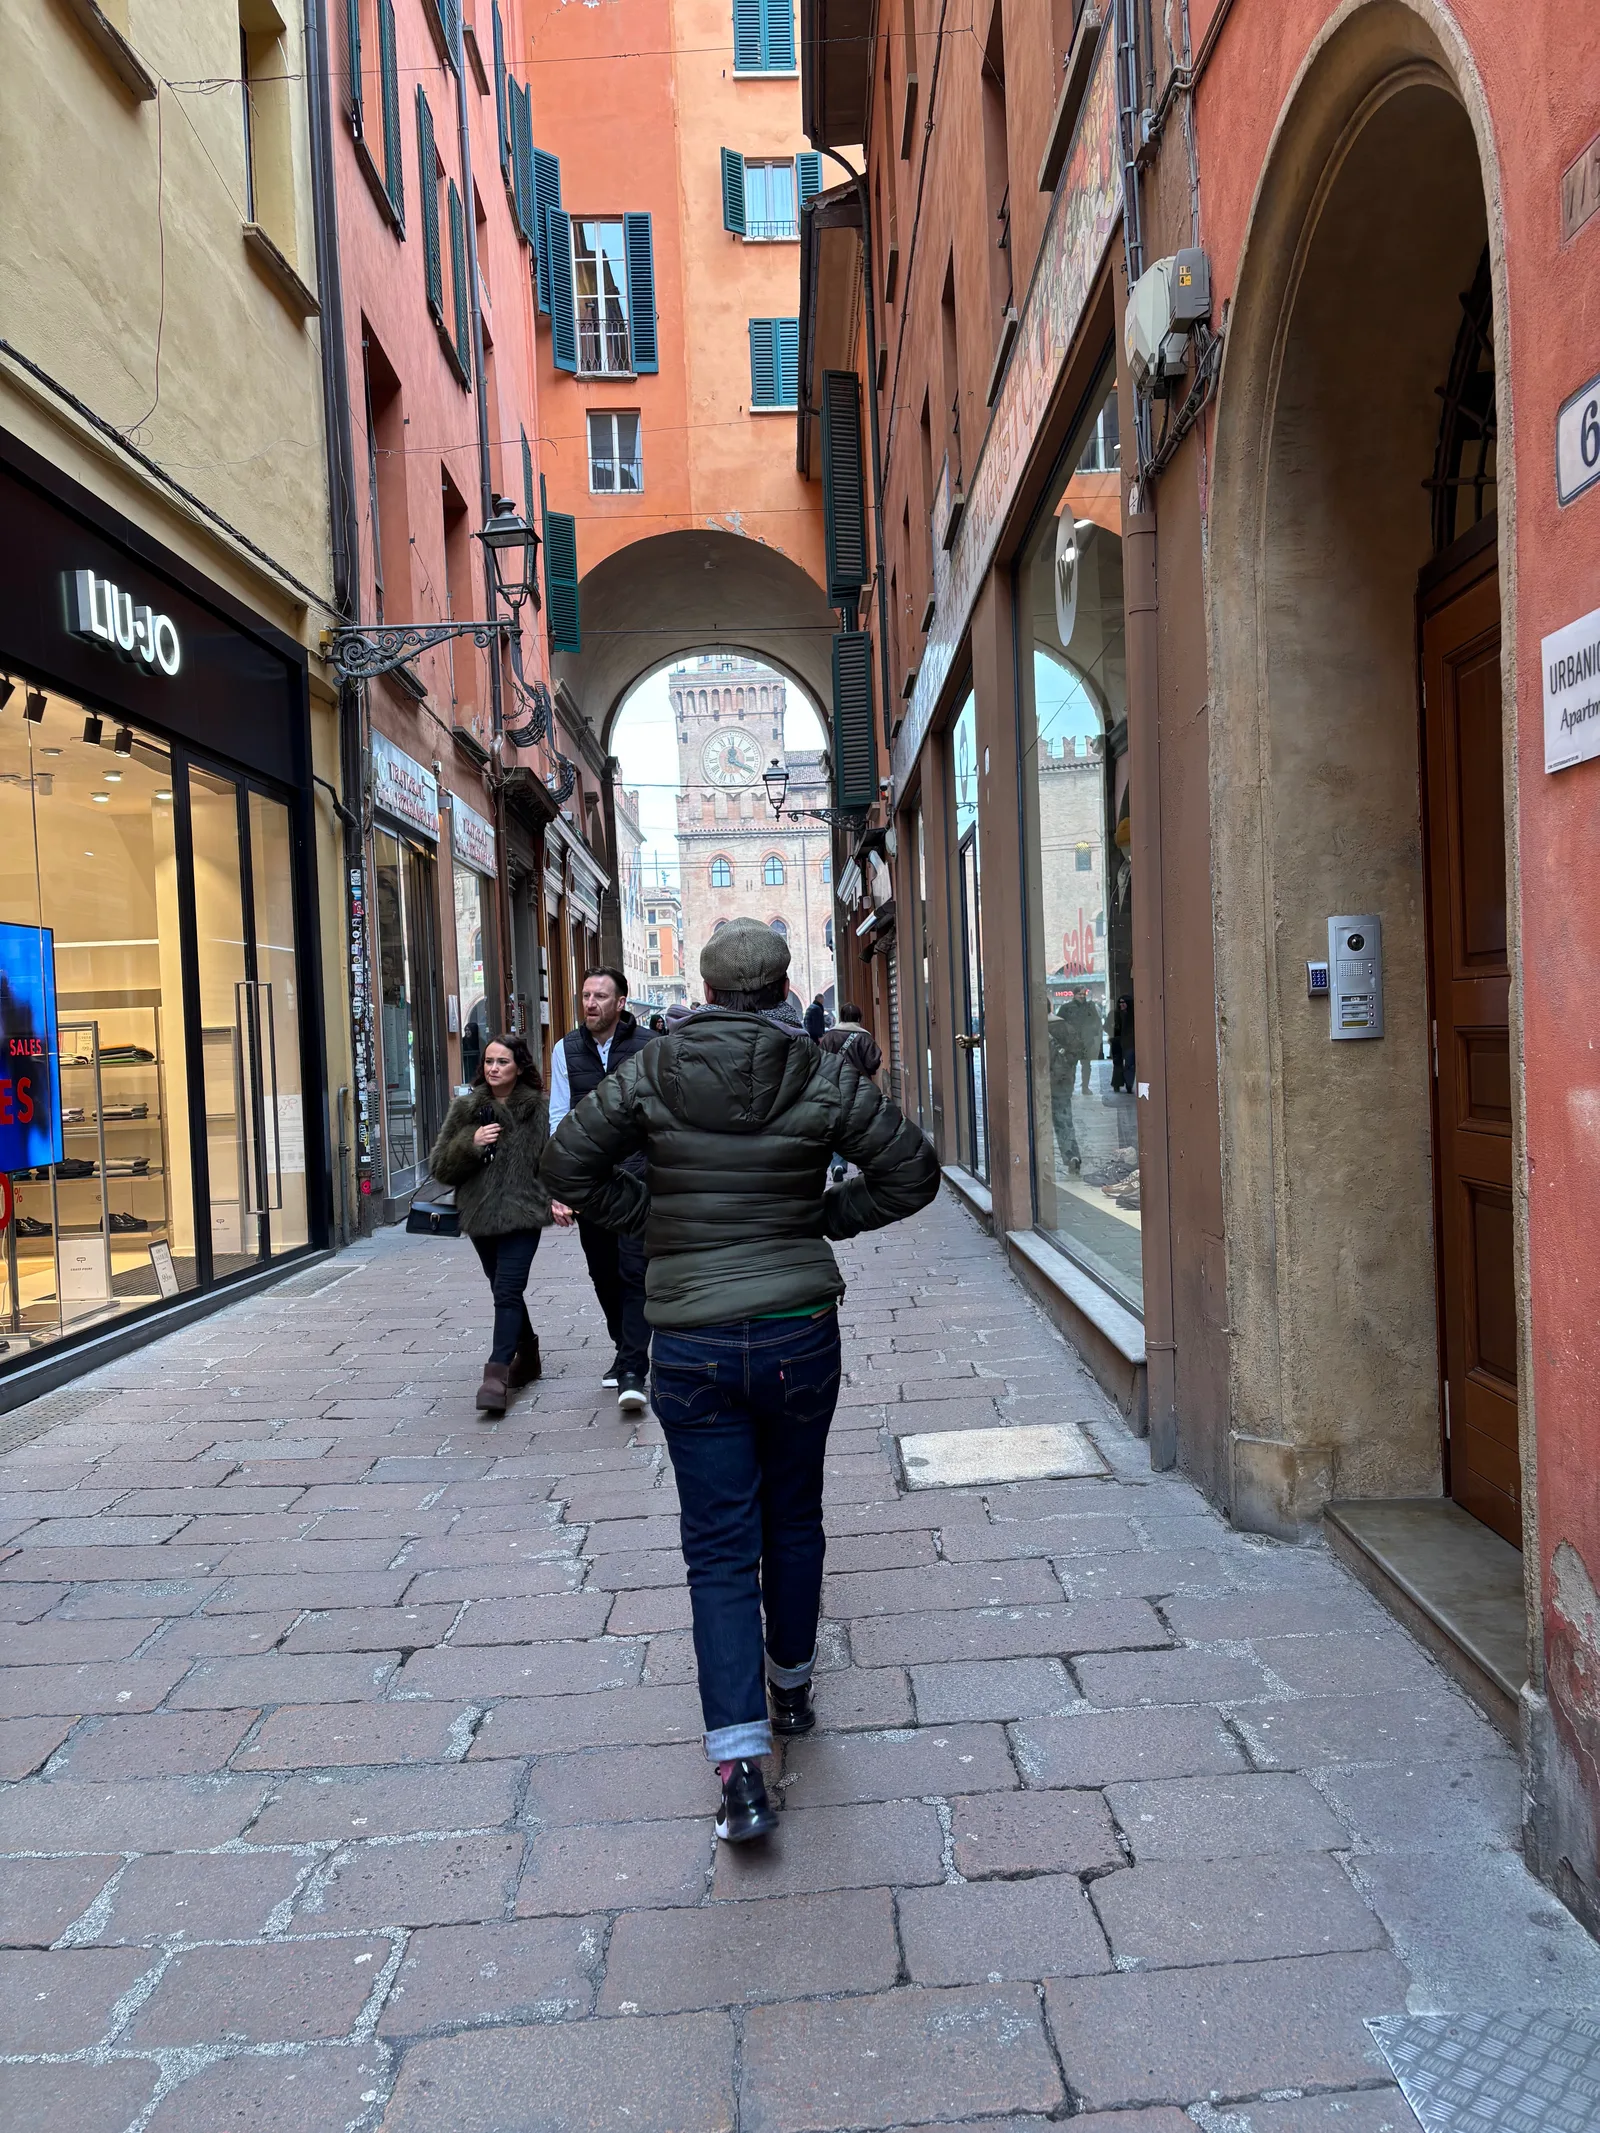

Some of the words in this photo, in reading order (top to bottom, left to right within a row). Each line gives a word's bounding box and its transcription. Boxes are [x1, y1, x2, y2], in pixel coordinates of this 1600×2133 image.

[1581, 400, 1600, 467] 6
[1063, 908, 1094, 978] sale
[9, 1038, 42, 1056] SALES
